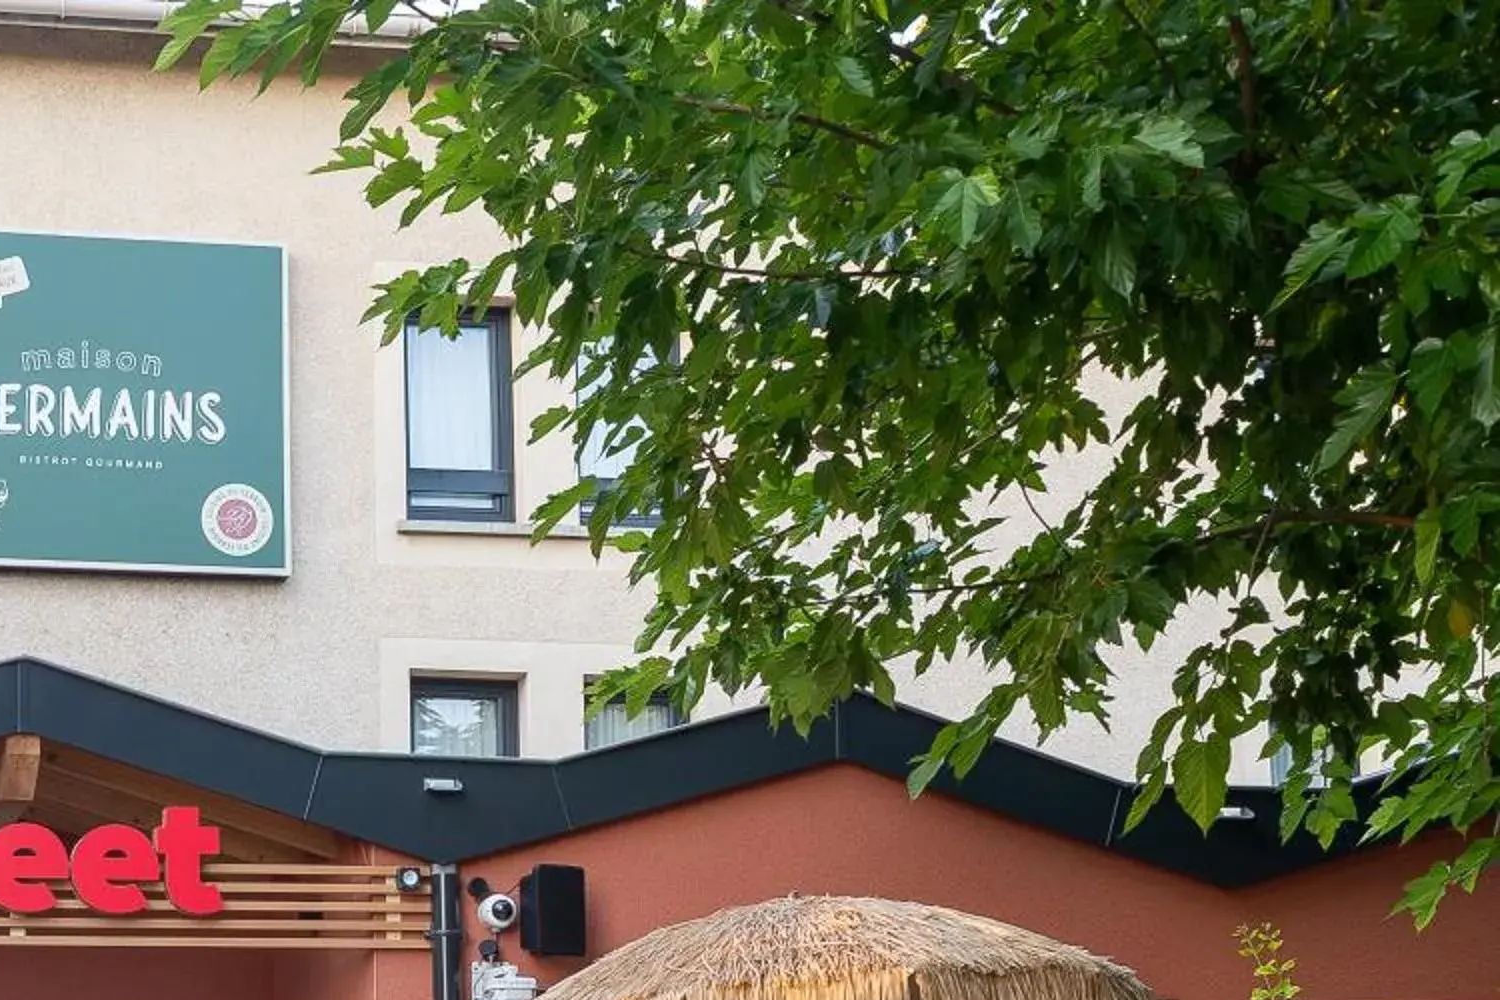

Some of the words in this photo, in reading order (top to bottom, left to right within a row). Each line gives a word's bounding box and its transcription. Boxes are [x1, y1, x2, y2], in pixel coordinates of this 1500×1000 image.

[21, 340, 163, 377] maison
[19, 455, 78, 466] BISTROT
[85, 457, 164, 470] GOURMAND
